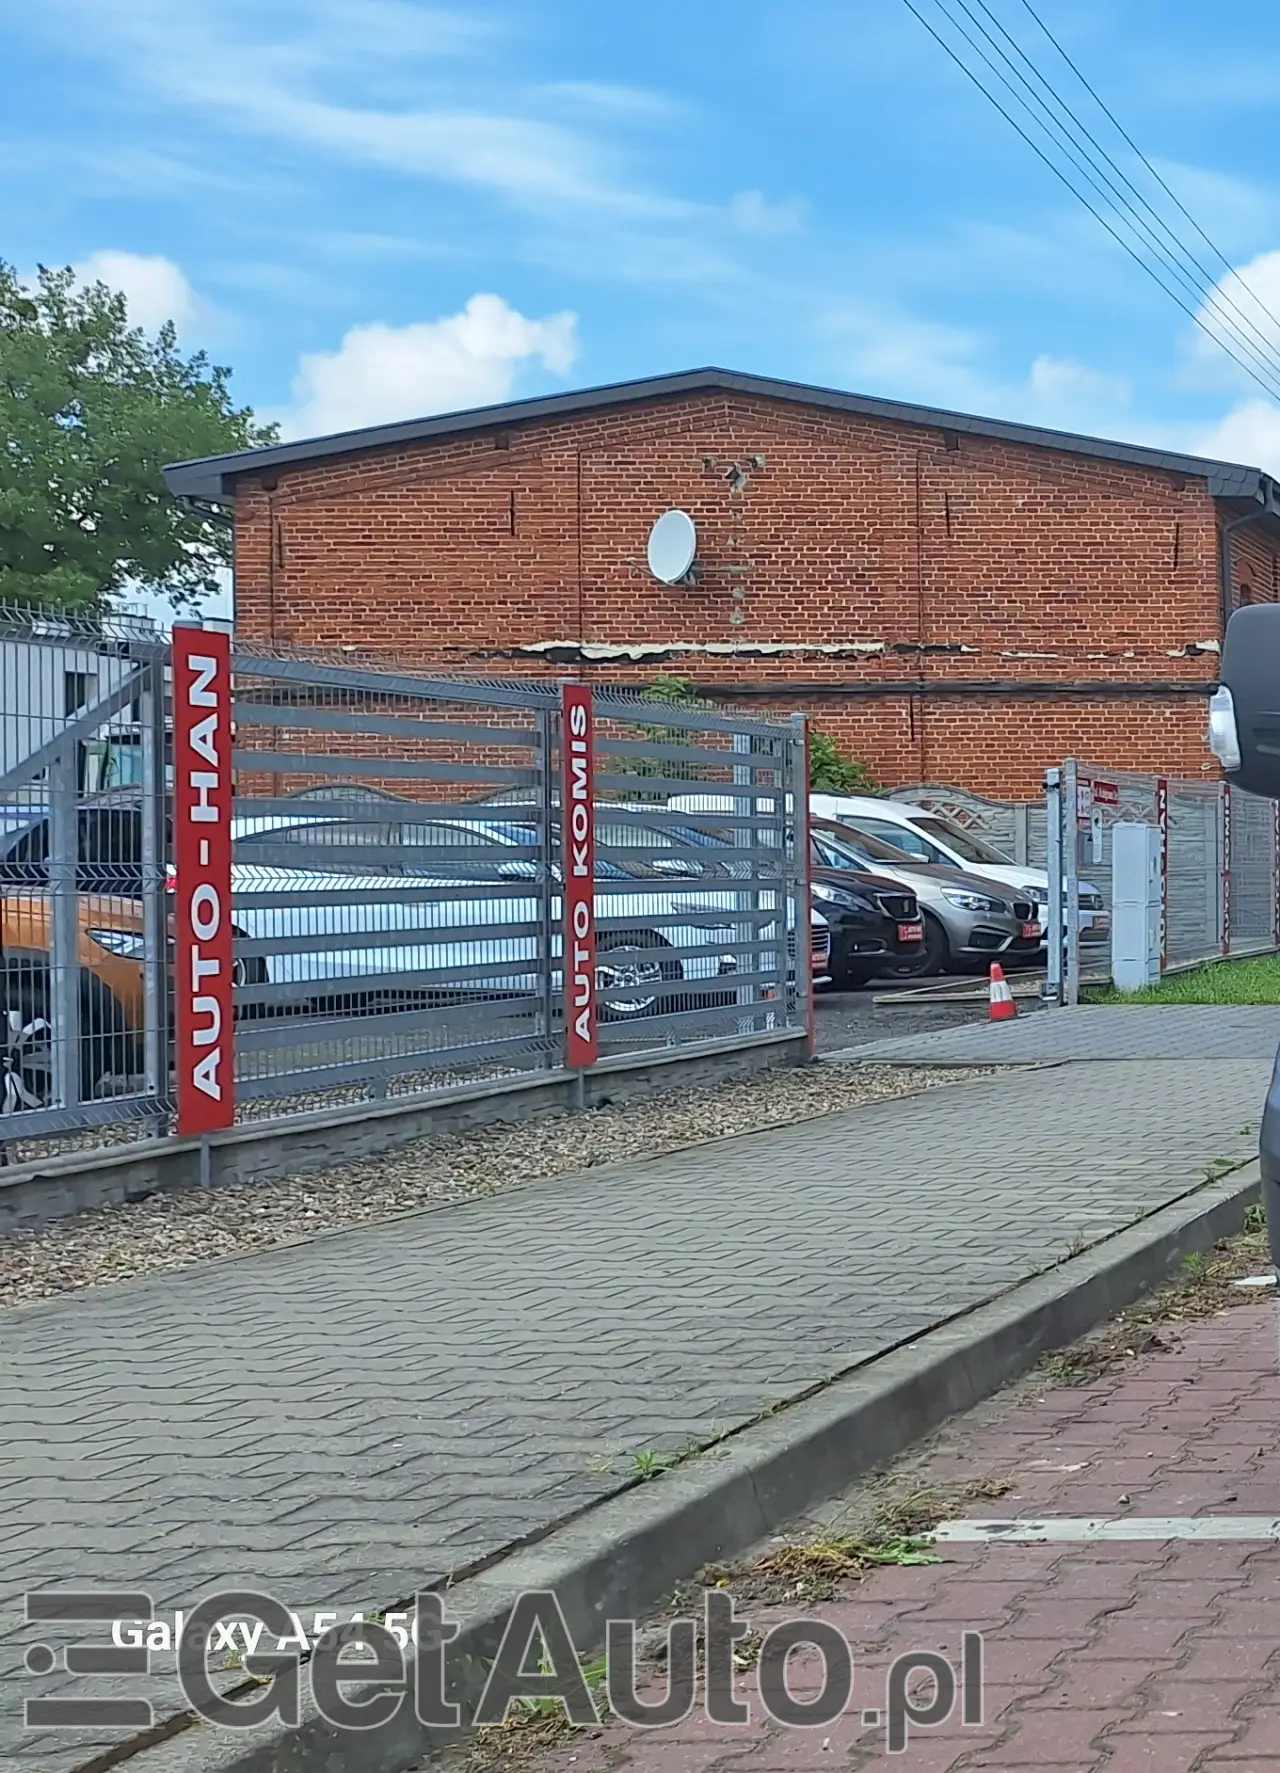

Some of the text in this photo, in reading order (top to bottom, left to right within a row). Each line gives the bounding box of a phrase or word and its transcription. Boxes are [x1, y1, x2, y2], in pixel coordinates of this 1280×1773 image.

[187, 654, 220, 1102] AUTO-HAN
[570, 704, 591, 1043] AUTO KOMIS
